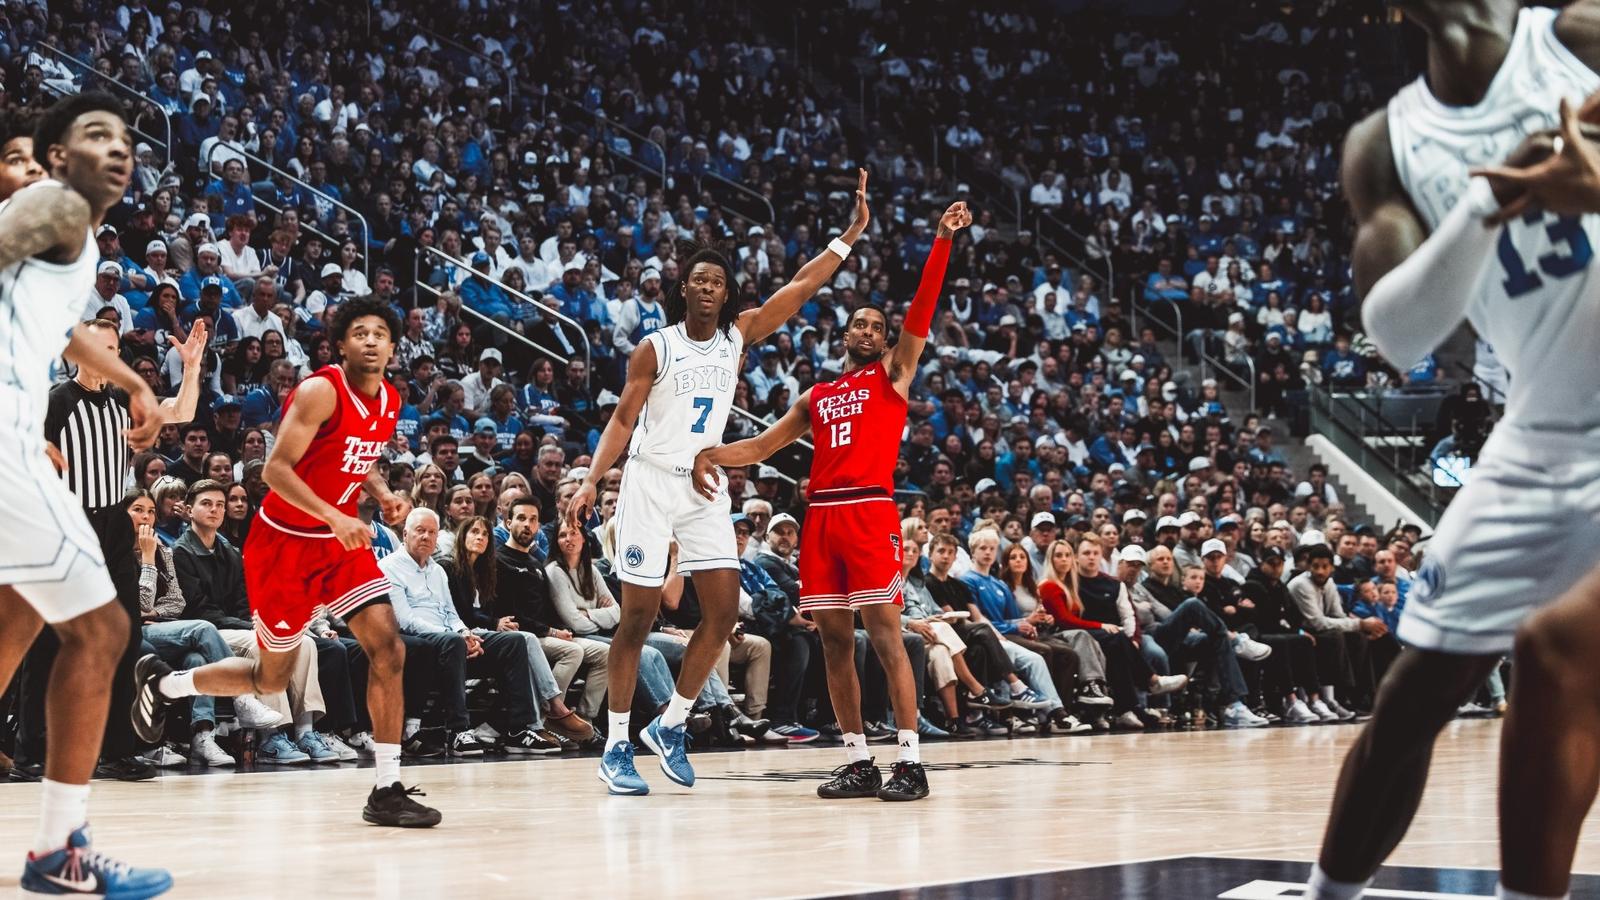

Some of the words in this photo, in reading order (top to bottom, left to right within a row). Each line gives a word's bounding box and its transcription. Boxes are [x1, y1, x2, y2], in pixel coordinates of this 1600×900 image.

[1497, 206, 1594, 299] 13
[674, 365, 731, 396] BYU
[817, 389, 870, 413] TEXAS
[820, 402, 863, 424] TECH
[691, 397, 714, 433] 7
[831, 421, 851, 448] 12
[340, 455, 377, 474] TEC
[336, 482, 362, 505] 11
